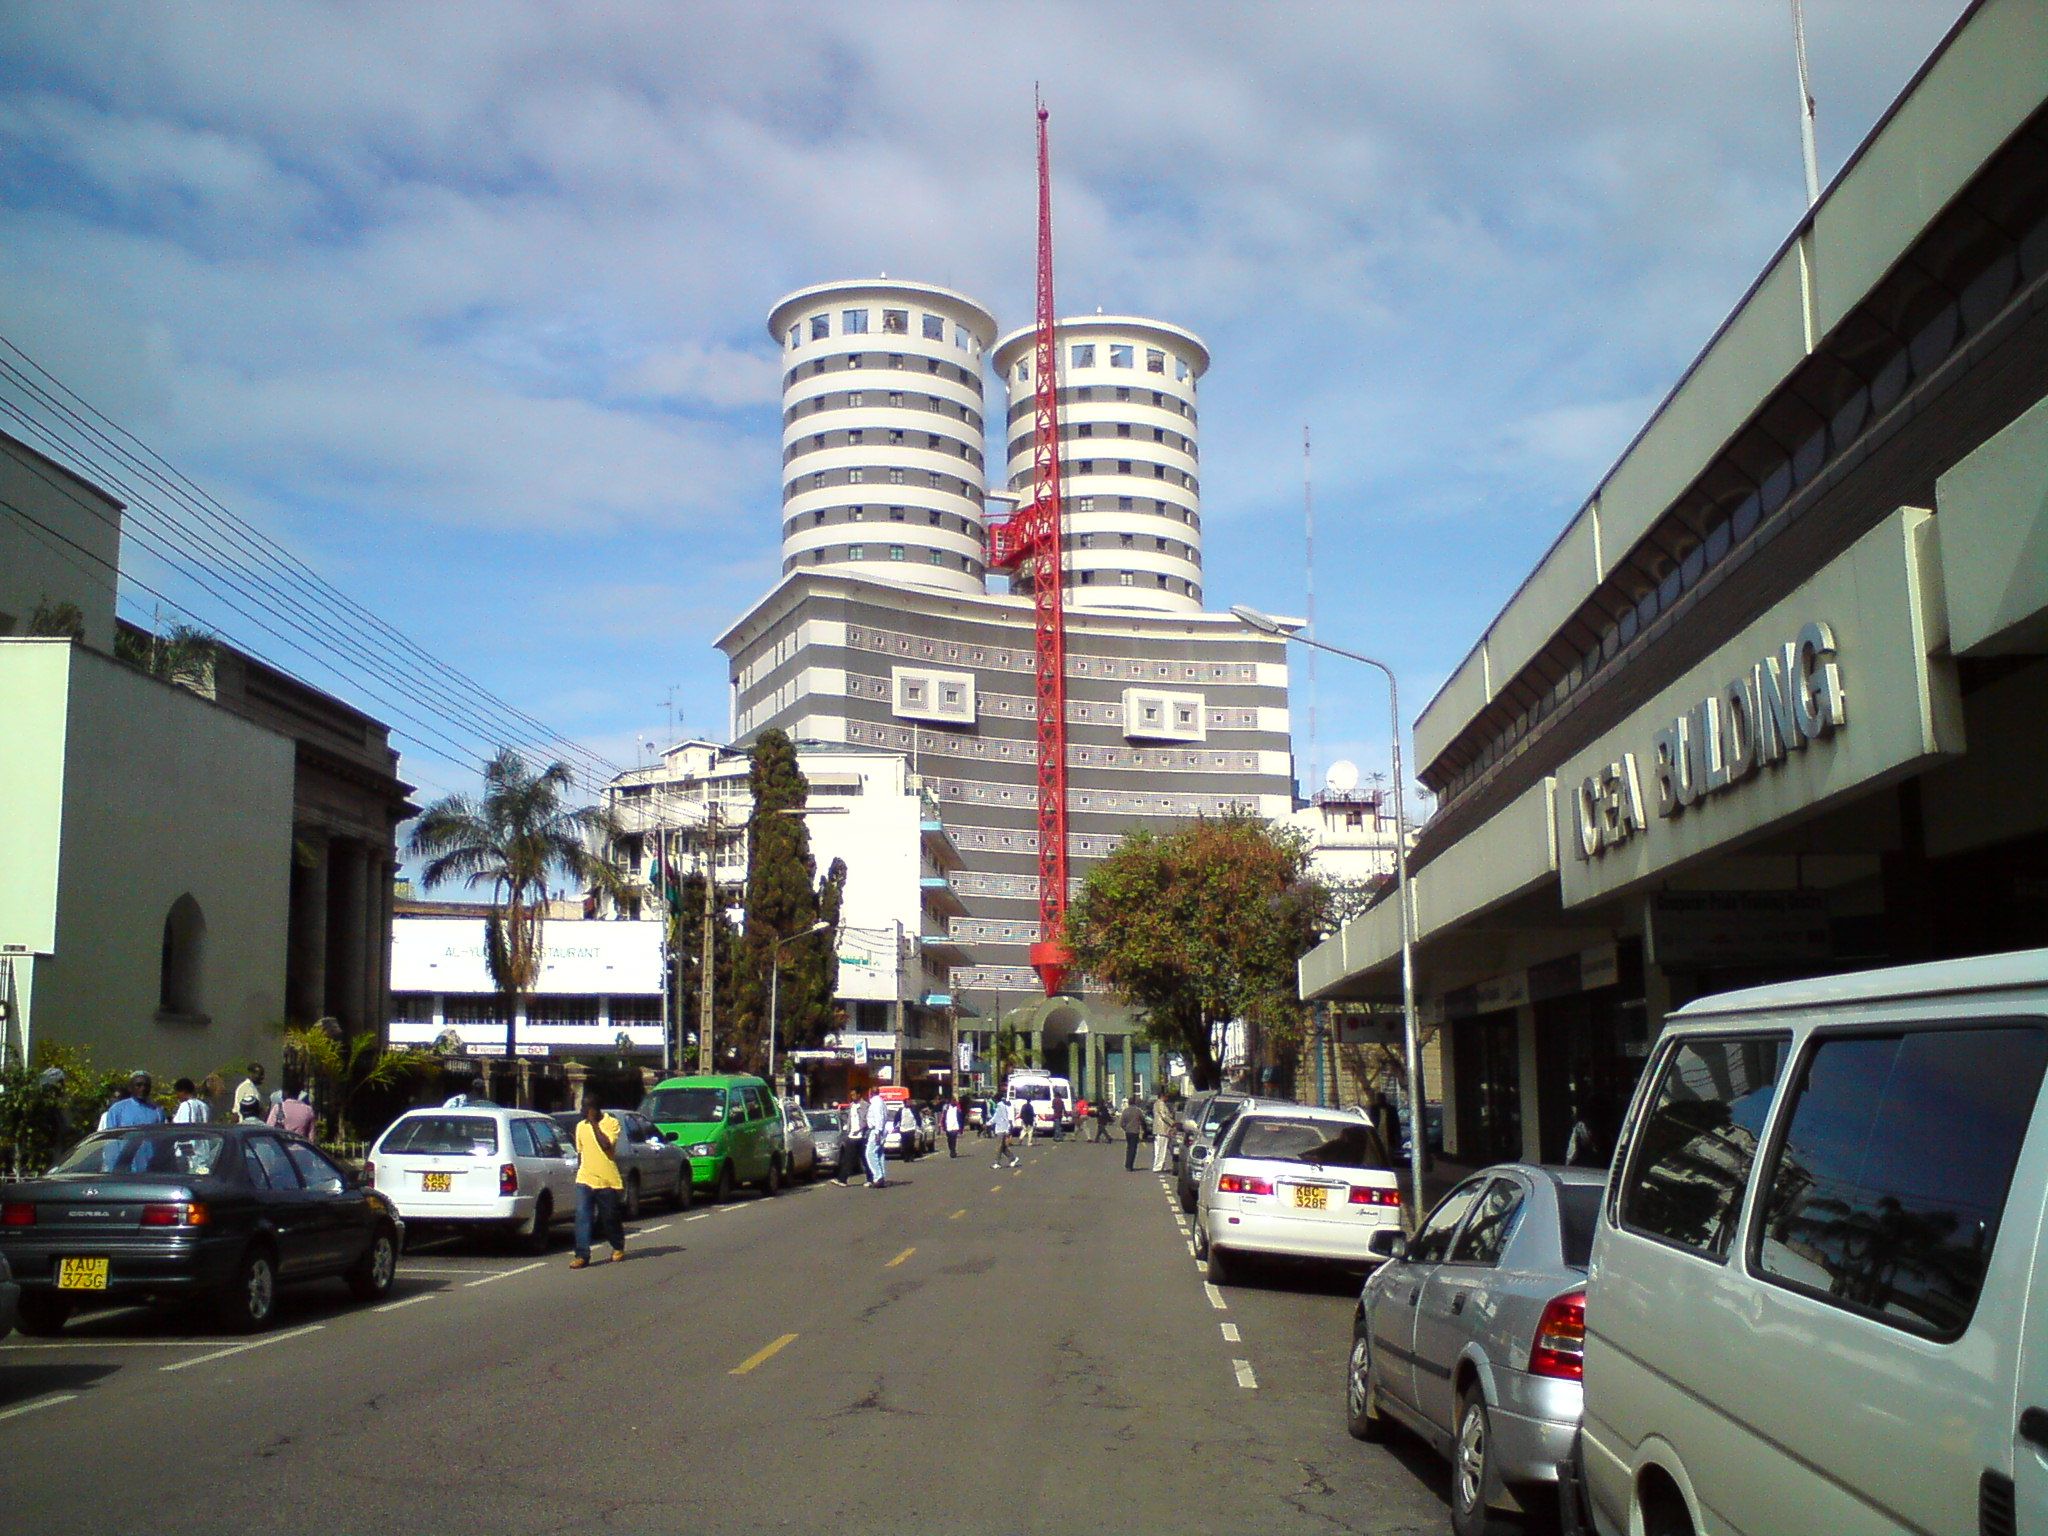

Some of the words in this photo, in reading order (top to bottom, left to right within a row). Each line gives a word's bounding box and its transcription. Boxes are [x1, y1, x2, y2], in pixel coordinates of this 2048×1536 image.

[1572, 753, 1646, 860] ICEA
[1652, 622, 1845, 819] BUILDING
[539, 946, 601, 959] TAURANT
[1296, 1196, 1327, 1210] 328F
[63, 1273, 103, 1288] 373G
